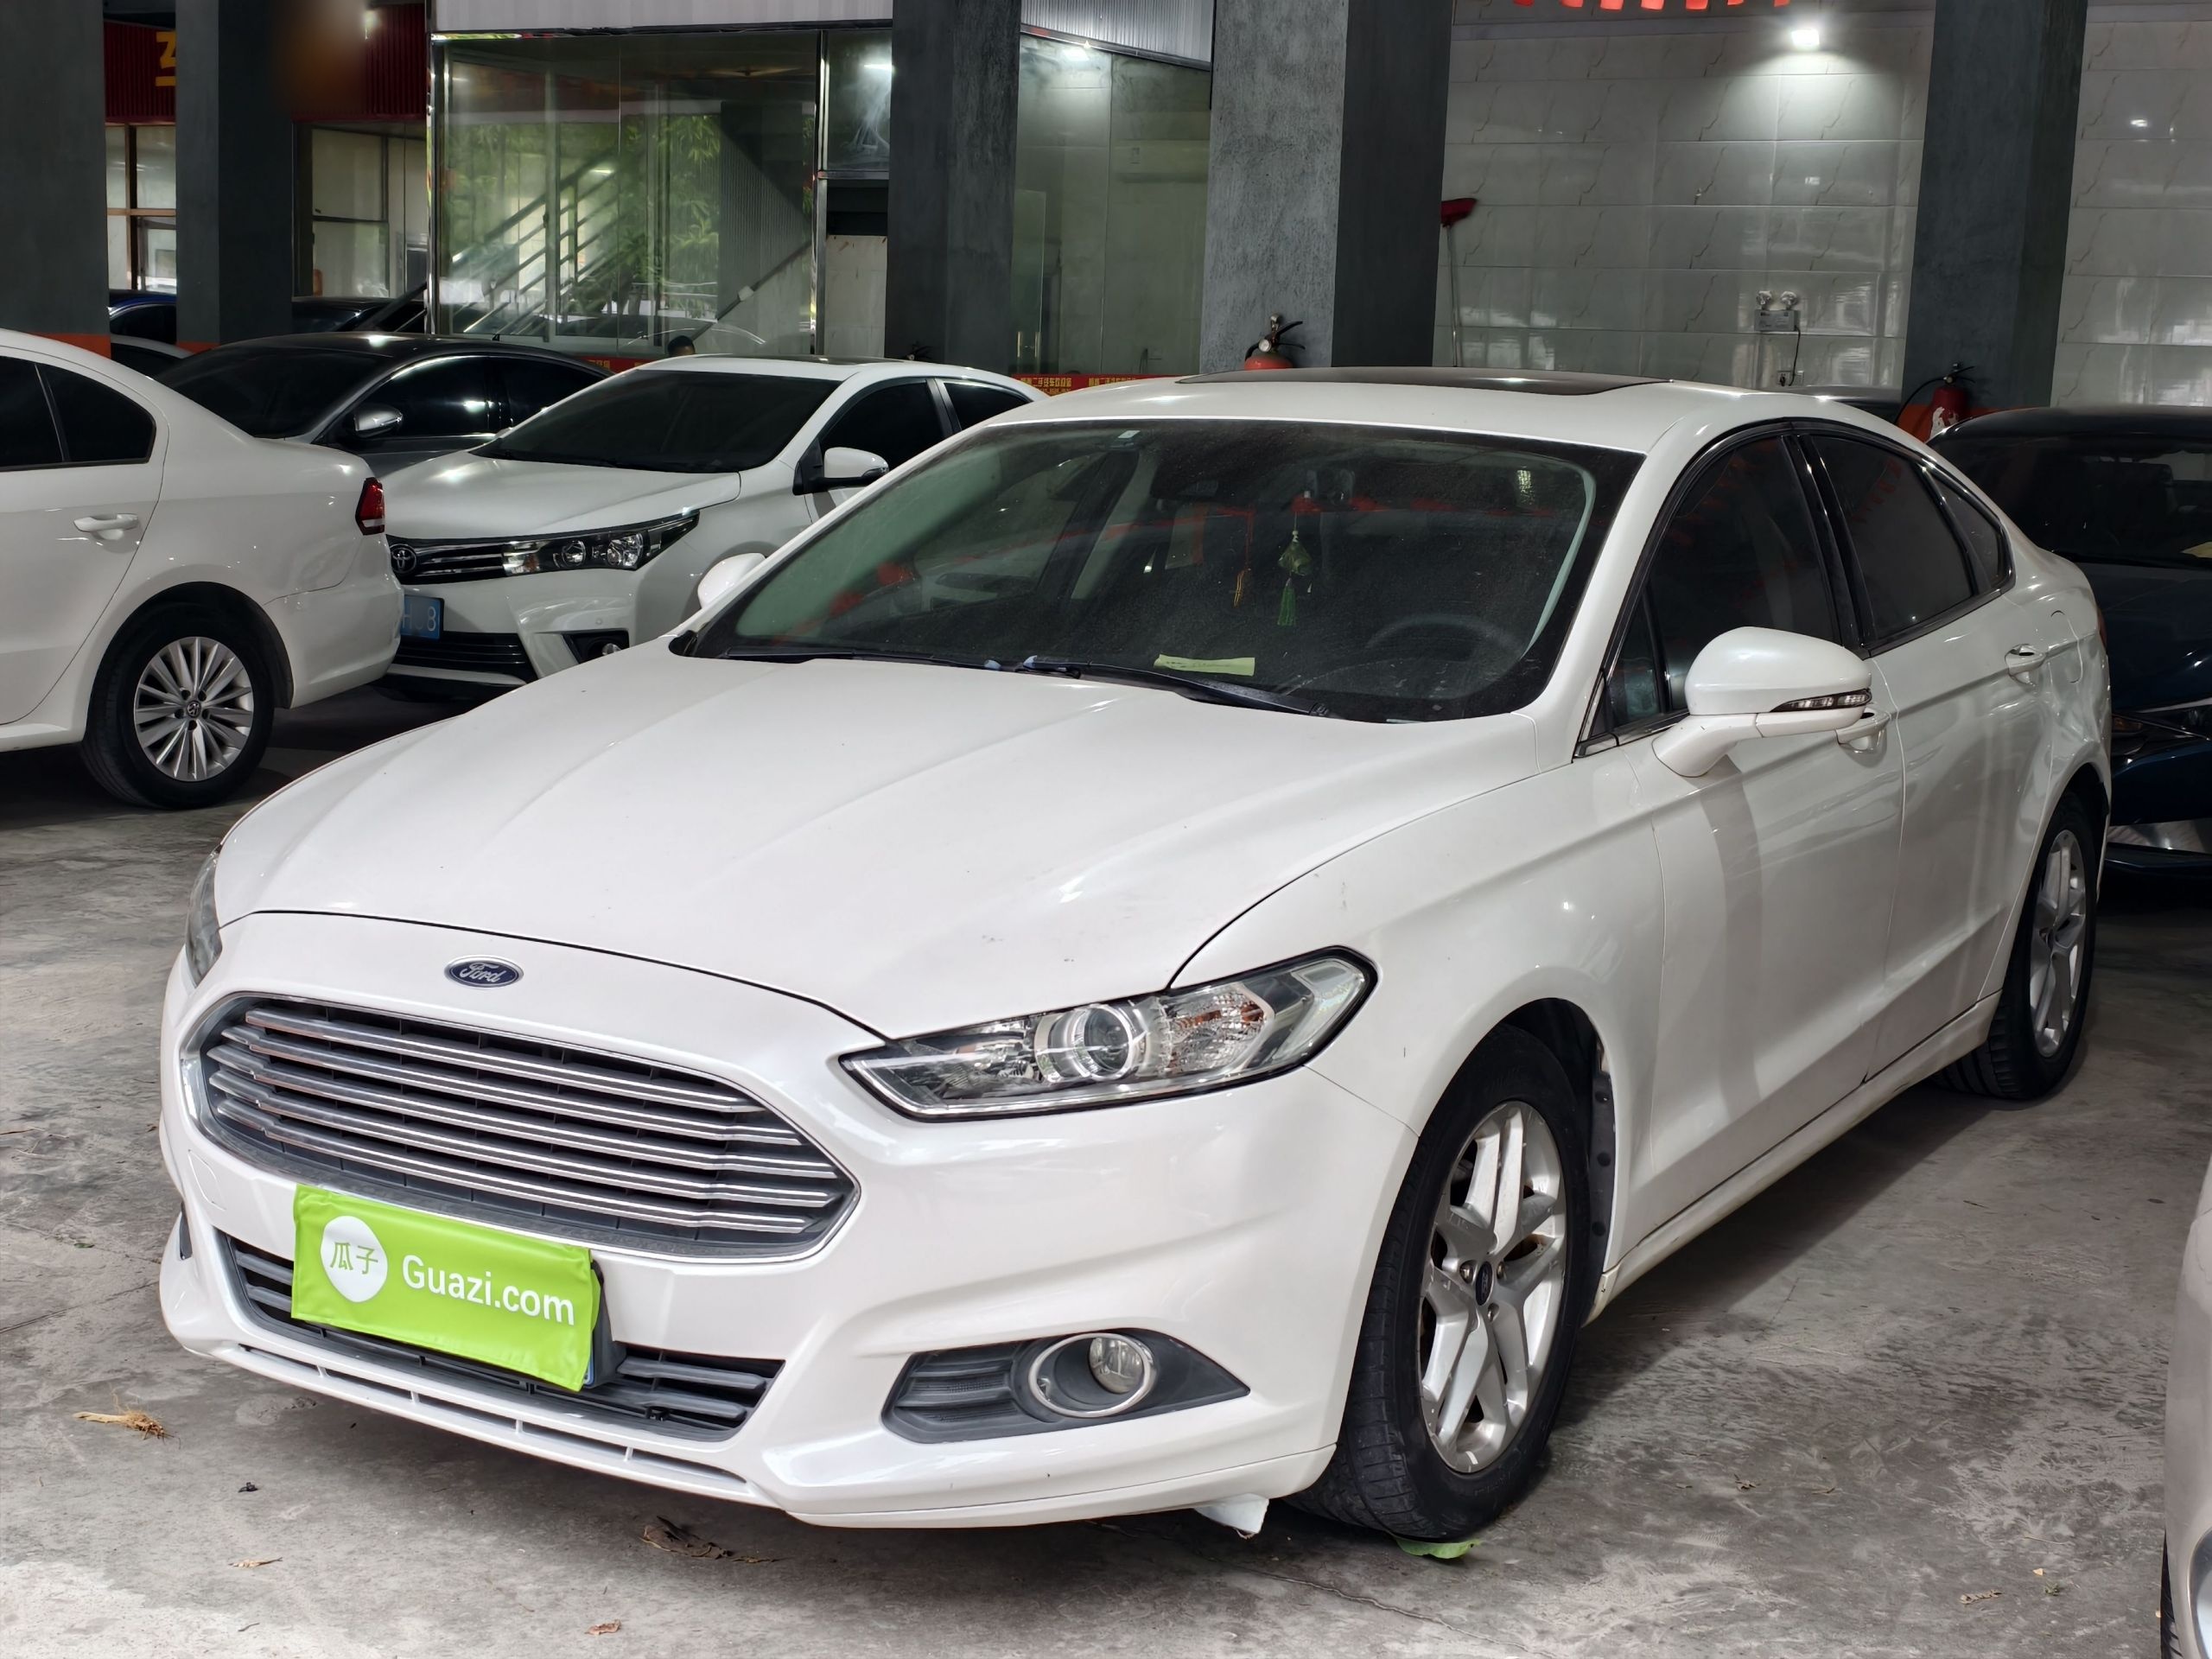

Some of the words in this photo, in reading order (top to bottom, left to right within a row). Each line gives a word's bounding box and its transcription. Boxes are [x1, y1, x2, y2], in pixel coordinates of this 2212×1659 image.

[459, 962, 506, 982] Ford
[329, 1241, 378, 1275] 瓜子
[401, 1254, 575, 1326] Guazi.com
